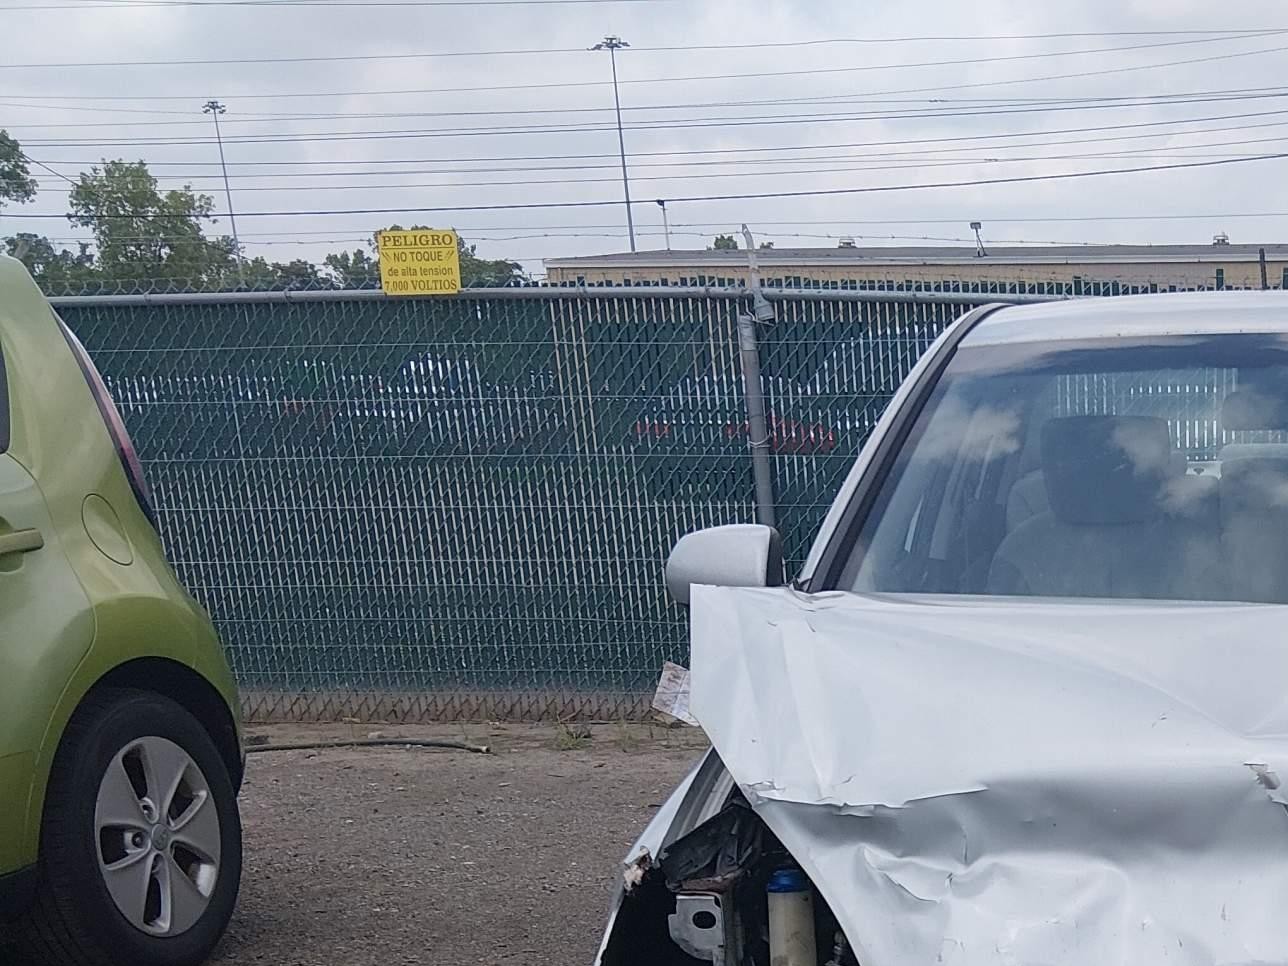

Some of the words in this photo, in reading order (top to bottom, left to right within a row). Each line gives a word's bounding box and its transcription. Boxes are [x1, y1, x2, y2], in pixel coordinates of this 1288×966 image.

[382, 234, 453, 247] PELIGRO
[393, 252, 407, 262] NO
[409, 251, 443, 262] TOQUE
[387, 267, 399, 276] de
[401, 266, 417, 276] alta
[420, 266, 453, 276] tension
[384, 281, 409, 291] 7,000
[410, 279, 457, 291] VOLTIOS
